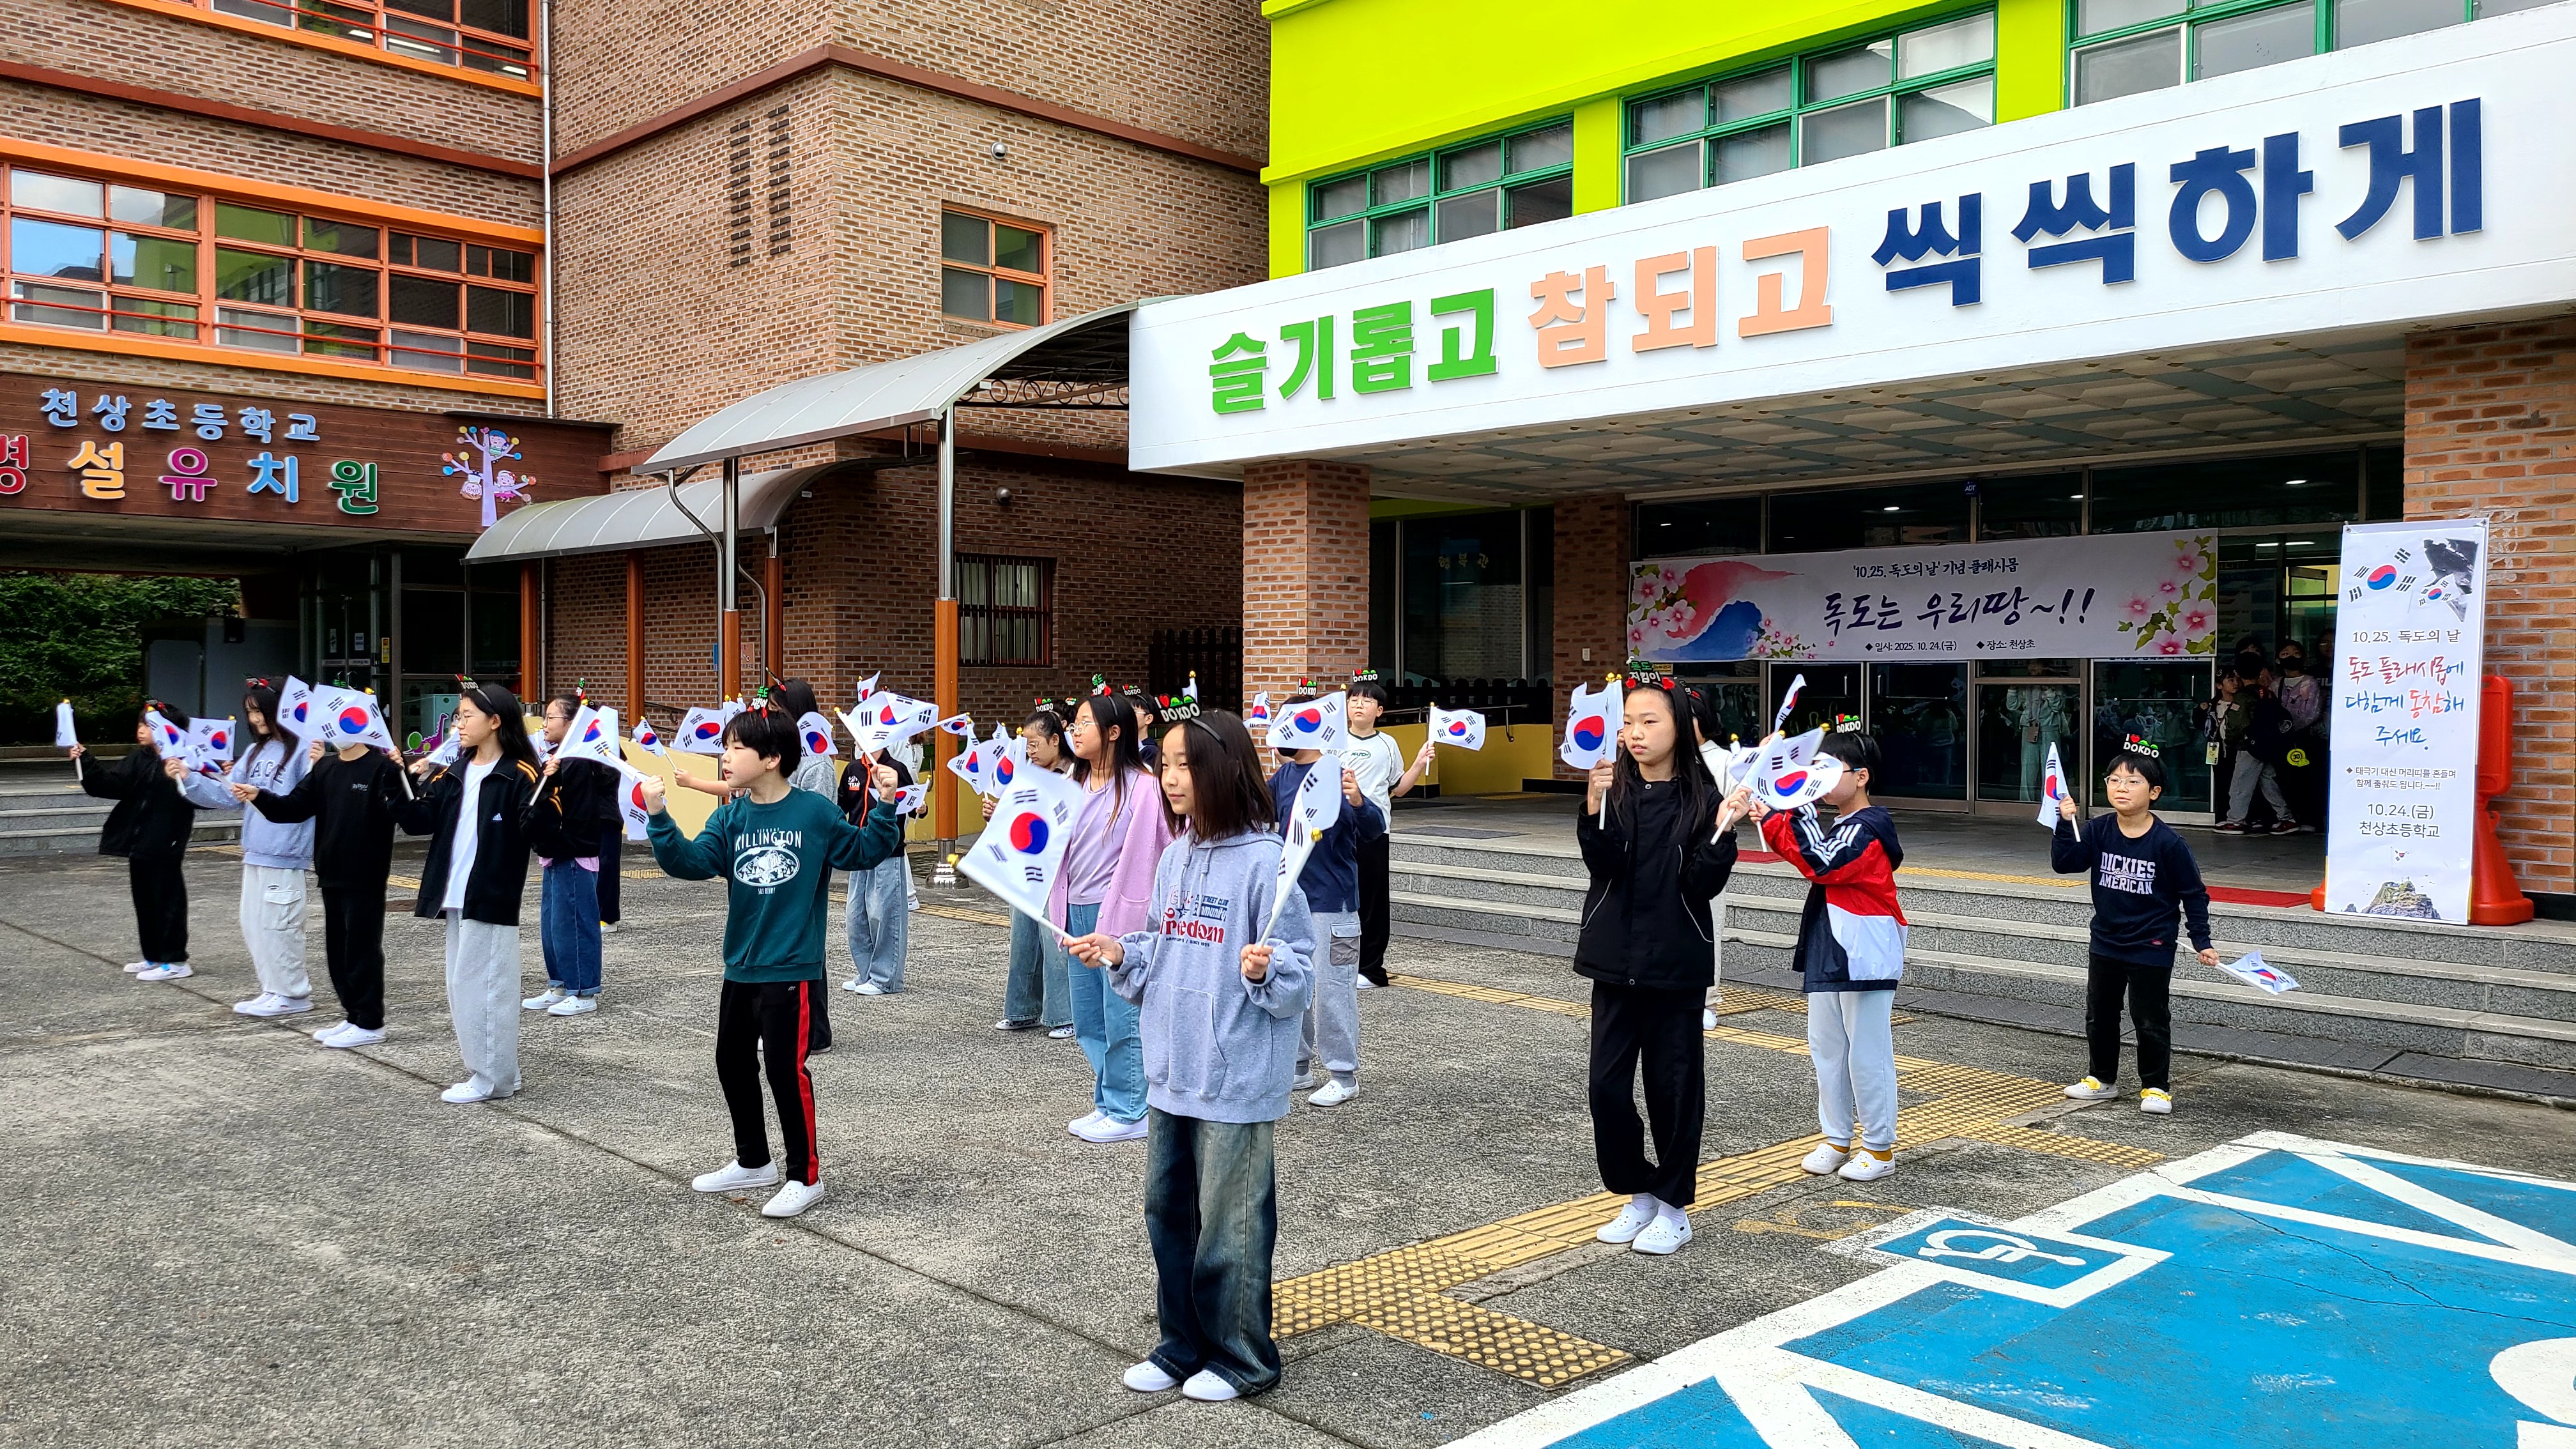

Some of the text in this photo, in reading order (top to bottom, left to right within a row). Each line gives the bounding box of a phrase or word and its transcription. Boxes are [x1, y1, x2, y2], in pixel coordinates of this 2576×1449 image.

[1209, 96, 2483, 414] 슬기롭고 참되고 씩씩하게
[40, 388, 320, 443] 천상초등학교
[1943, 560, 1965, 575] 기념
[1968, 557, 2019, 574] 플래시몹
[1823, 592, 1903, 637] 독도는
[2353, 629, 2461, 643] 10.25. 독도의 날
[1874, 643, 1893, 652] 일시:
[1929, 641, 1957, 651] 24.(금)
[1986, 640, 2035, 650] 장소: 천상초
[1630, 661, 1652, 672] 독도
[2349, 656, 2464, 686] 독도 플래시몹에
[1353, 674, 1378, 682] DOKDO
[1629, 671, 1660, 683] 지킴이
[1036, 703, 1054, 712] DOKDO
[1154, 696, 1162, 709] I
[2345, 689, 2464, 718] 다함께 동참해
[1160, 703, 1200, 722] DOKDO
[1837, 721, 1861, 733] DOKDO
[2375, 726, 2428, 750] 주세요.
[2123, 742, 2159, 758] DOKDO
[2356, 767, 2456, 778] 태극기 대신 머리띠를 흔들며
[2356, 779, 2372, 787] 함께
[2373, 780, 2397, 788] 춤춰도
[2367, 804, 2434, 820] 10.24.(금)
[2359, 821, 2440, 838] 천상초등학교
[735, 831, 802, 852] KILLINGTON
[2100, 852, 2156, 879] DICKIES
[2099, 873, 2152, 894] AMERICAN
